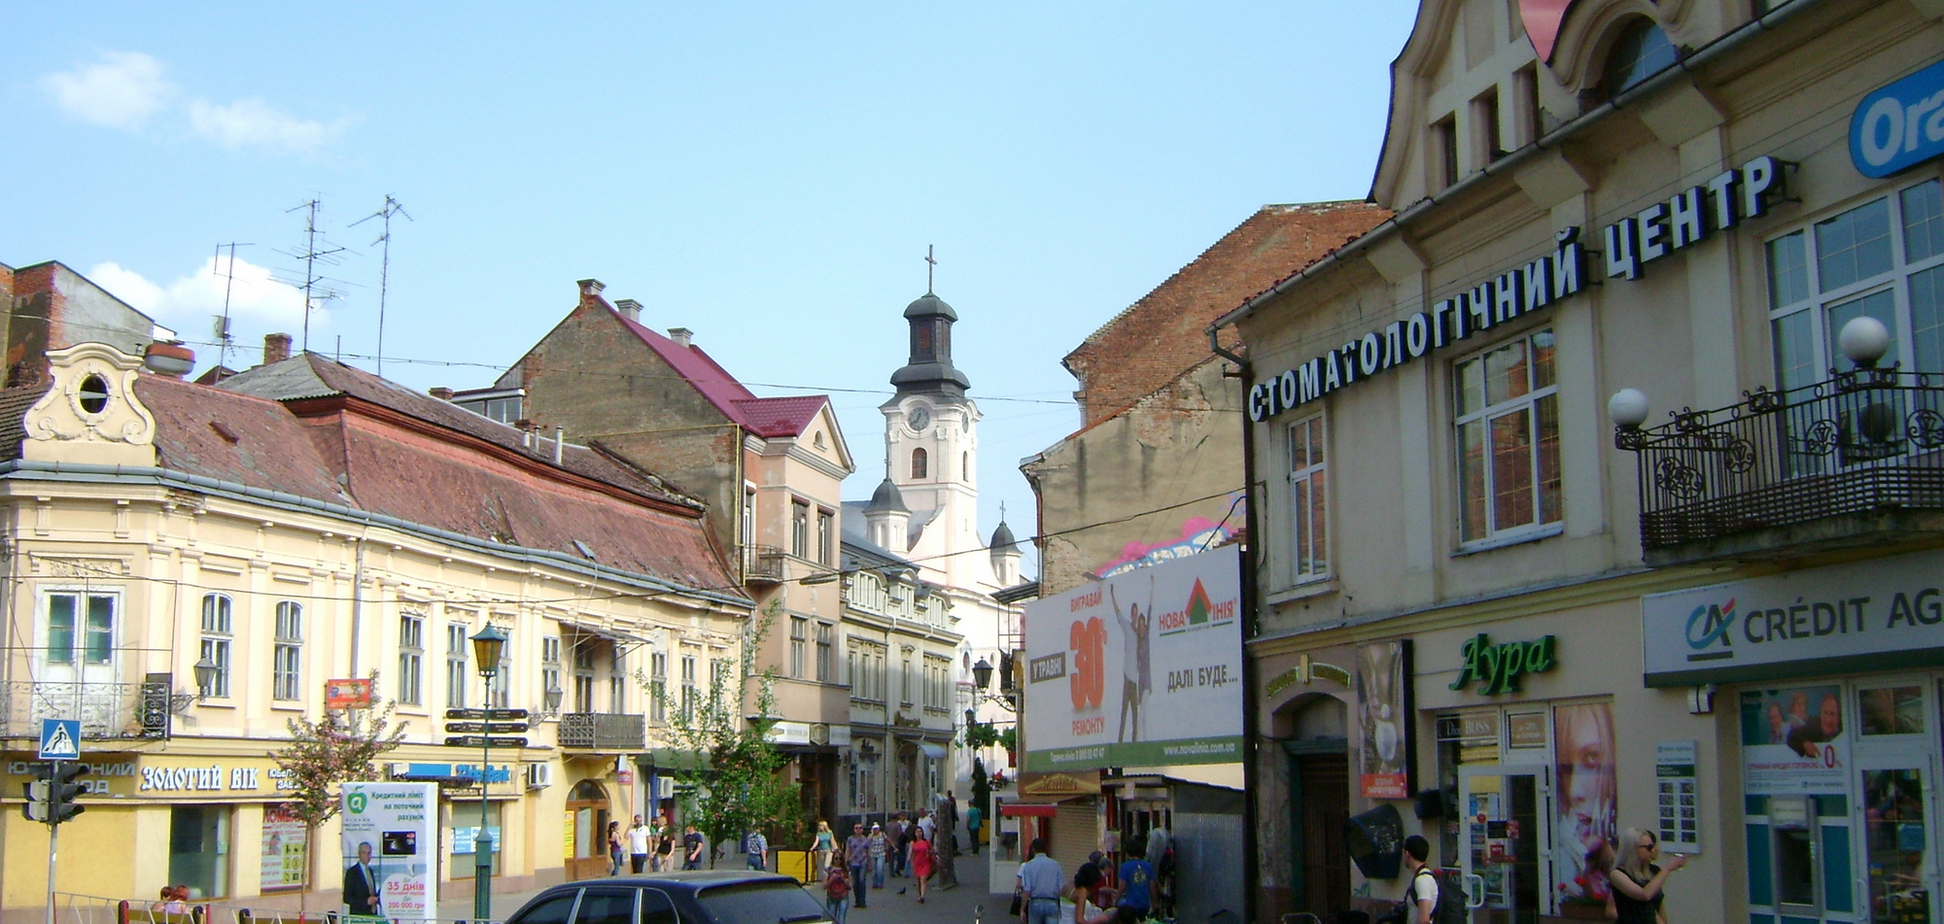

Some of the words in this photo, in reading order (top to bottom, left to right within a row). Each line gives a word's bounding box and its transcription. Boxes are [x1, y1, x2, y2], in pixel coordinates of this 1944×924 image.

[1248, 225, 1588, 423] СТОМАТОЛОГІЧНИЙ
[1605, 155, 1784, 281] ЦЕНТР
[1070, 588, 1103, 612] ВИГРАВАЙ
[1158, 611, 1186, 631] НОВА
[1744, 597, 1871, 644] CRÉDIT
[1033, 662, 1038, 679] У
[1039, 656, 1062, 678] ТРАВНІ
[1448, 633, 1556, 697] Аура
[1167, 668, 1194, 693] ДАЛІ
[1198, 664, 1238, 689] БУДЕ...
[1072, 716, 1105, 737] РЕМОНТУ
[1465, 720, 1490, 735] BOSS
[1163, 741, 1236, 756] www.novalinia.com.ua
[141, 764, 222, 790] ЗОЛОТИЙ
[231, 768, 259, 789] ВІК
[371, 791, 406, 800] Кредитний
[407, 791, 424, 800] ліміт
[393, 802, 424, 810] поточний
[397, 814, 425, 822] рахунок
[387, 881, 400, 891] 35
[402, 881, 425, 892] днів
